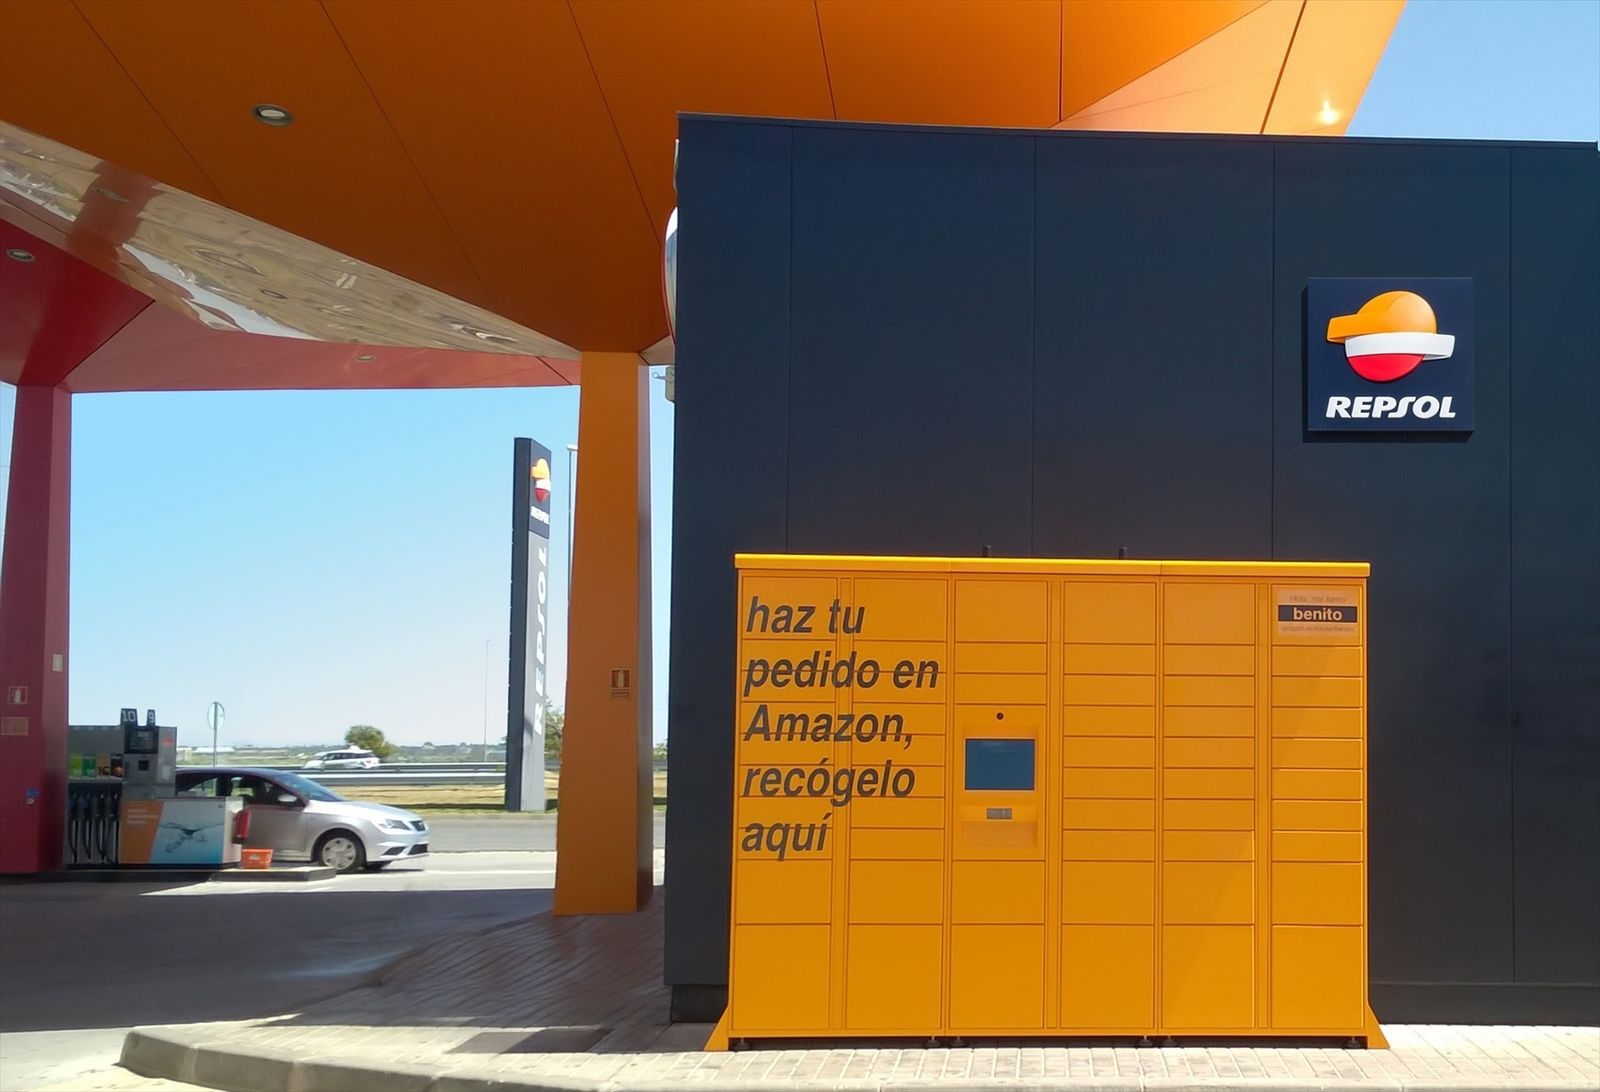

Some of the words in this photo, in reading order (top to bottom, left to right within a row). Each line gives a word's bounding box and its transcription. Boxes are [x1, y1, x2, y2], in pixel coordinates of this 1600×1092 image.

[1326, 395, 1456, 418] REPSOL
[747, 597, 815, 633] haz
[828, 599, 866, 634] tu
[1293, 607, 1342, 620] benito
[534, 547, 546, 735] REPSOL
[744, 651, 880, 697] pedido
[893, 660, 939, 688] en
[122, 710, 136, 722] 10
[744, 704, 913, 750] Amazon,
[743, 758, 915, 807] recógelo
[741, 812, 832, 861] aquí
